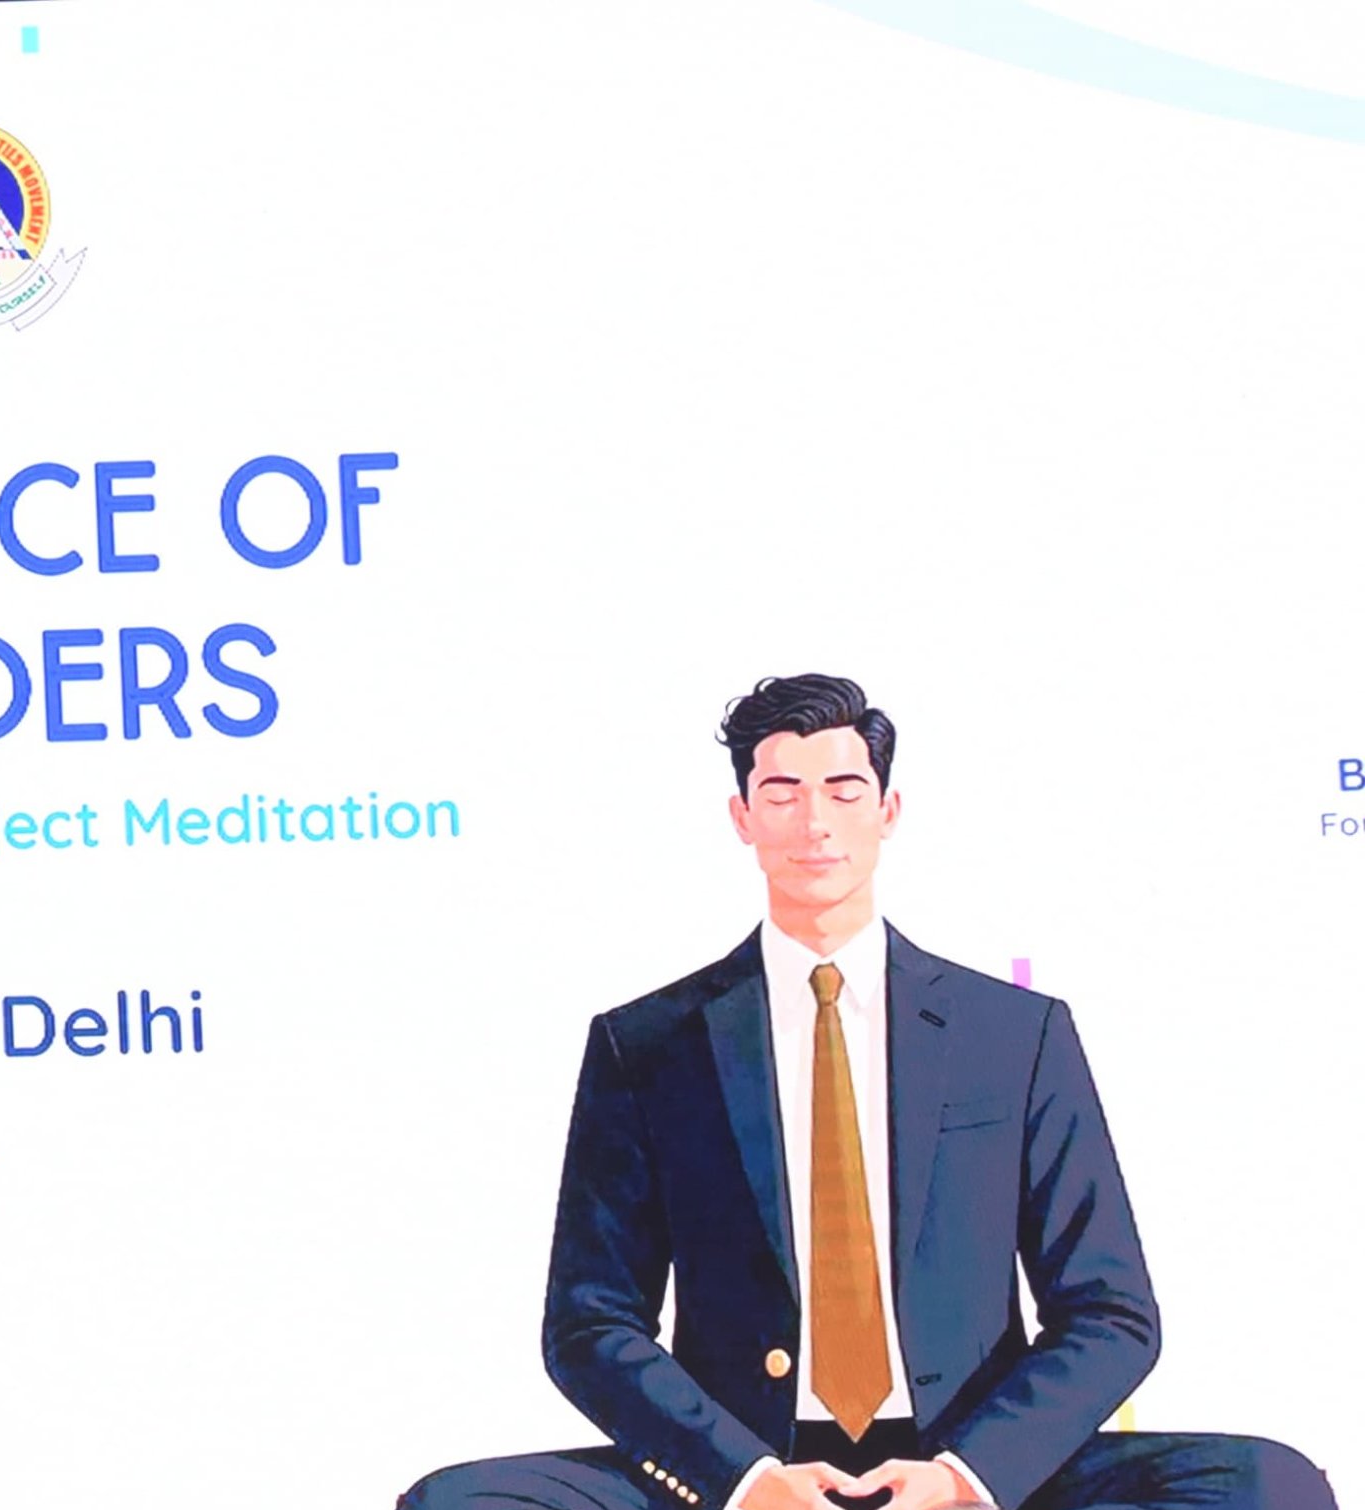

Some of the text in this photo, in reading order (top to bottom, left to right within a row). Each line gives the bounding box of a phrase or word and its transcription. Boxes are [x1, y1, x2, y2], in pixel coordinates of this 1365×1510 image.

[19, 165, 45, 244] MOVEMENT
[219, 451, 400, 571] OF
[123, 791, 460, 847] Meditation
[1, 989, 205, 1058] Delhi
